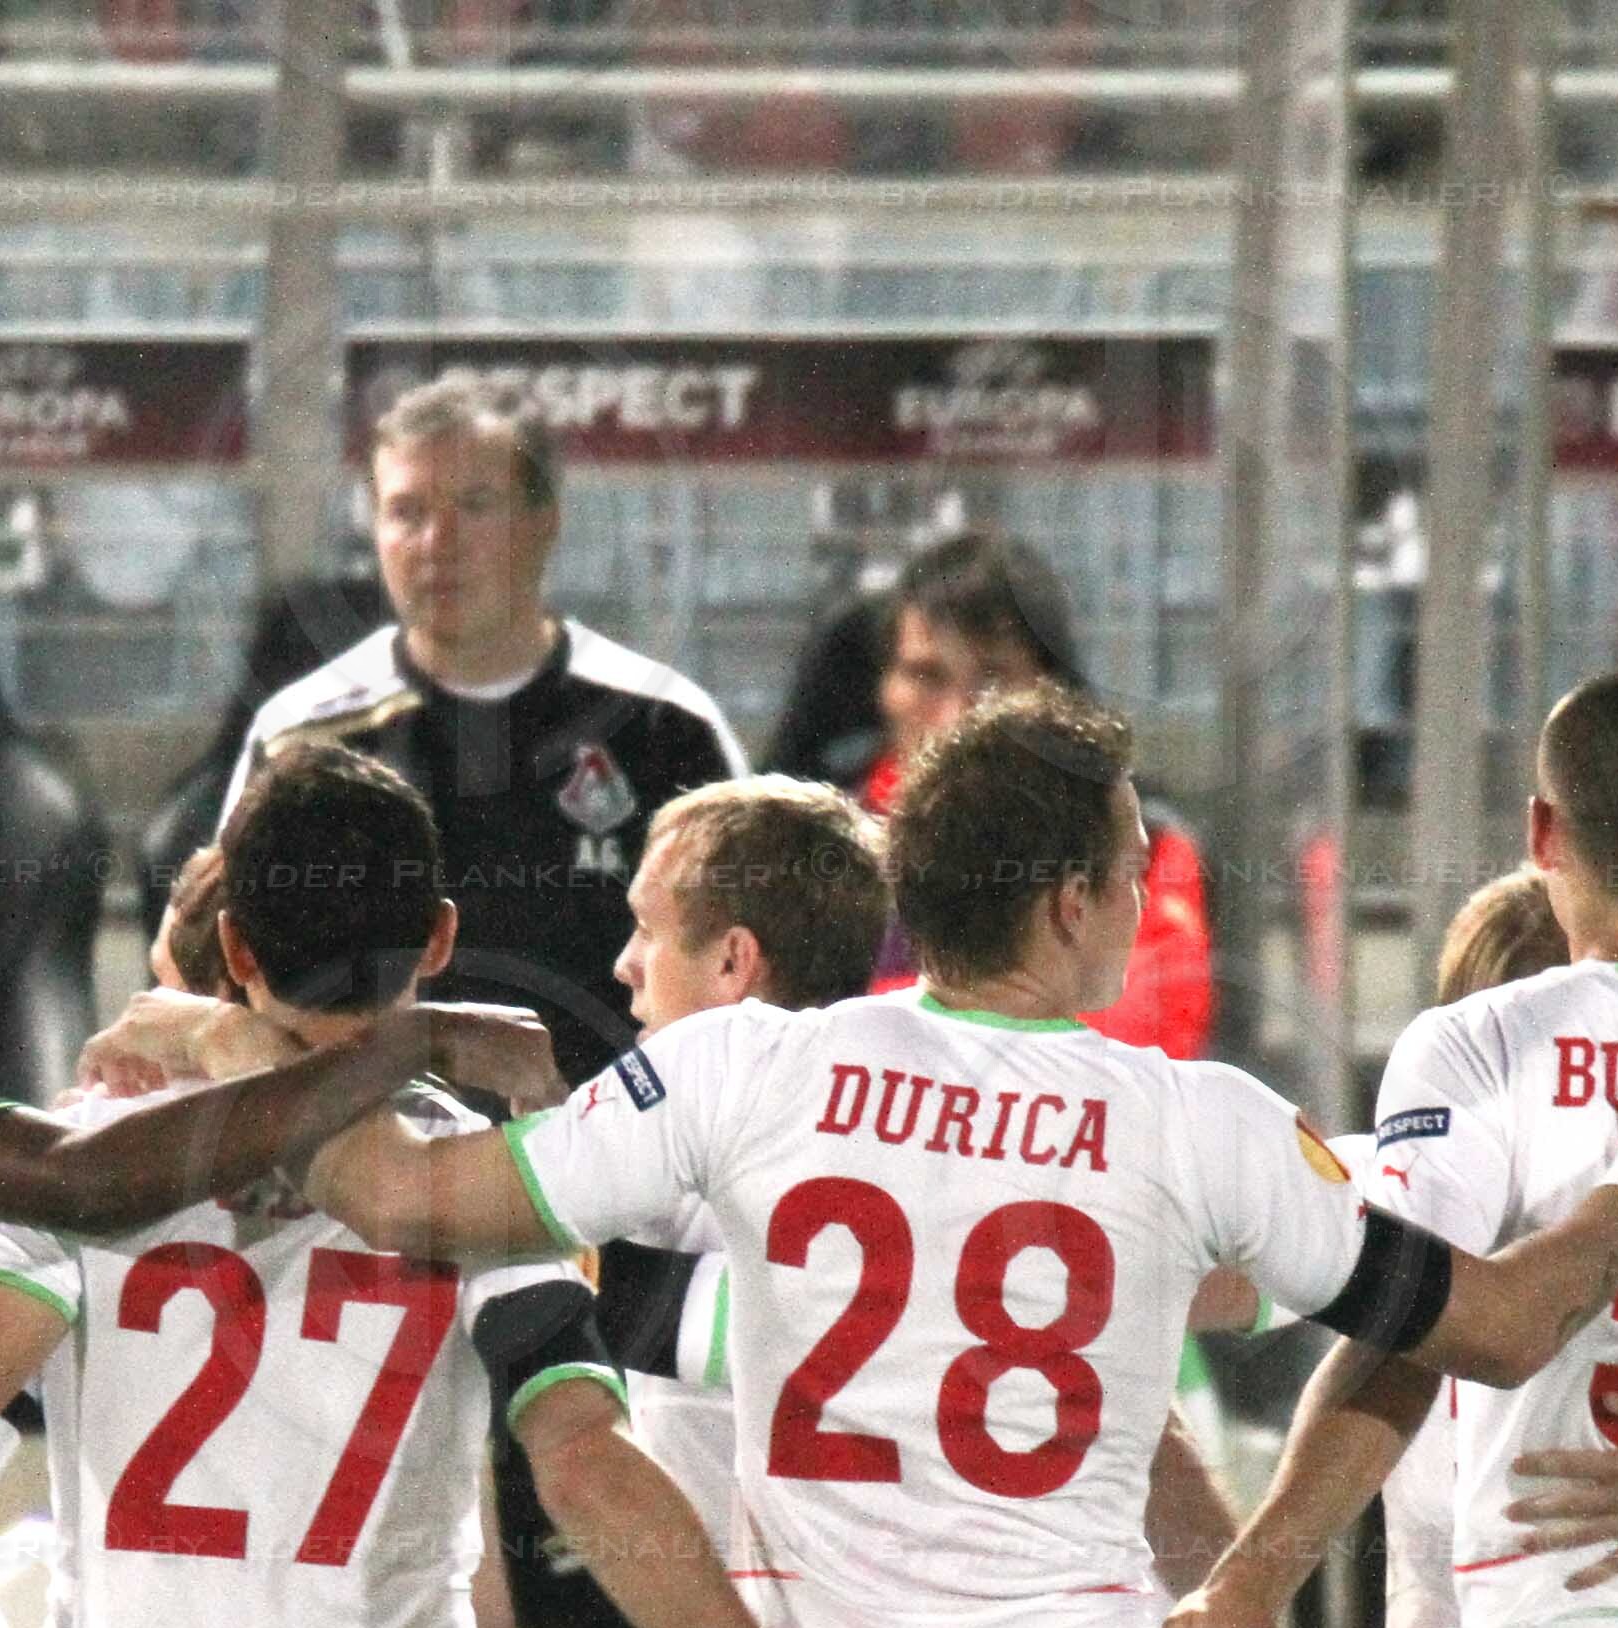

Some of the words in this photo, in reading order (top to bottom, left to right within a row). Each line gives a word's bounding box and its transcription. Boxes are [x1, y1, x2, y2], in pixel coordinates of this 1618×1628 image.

[815, 1063, 1109, 1173] DURICA
[104, 1240, 460, 1567] 27
[766, 1174, 1117, 1499] 28
